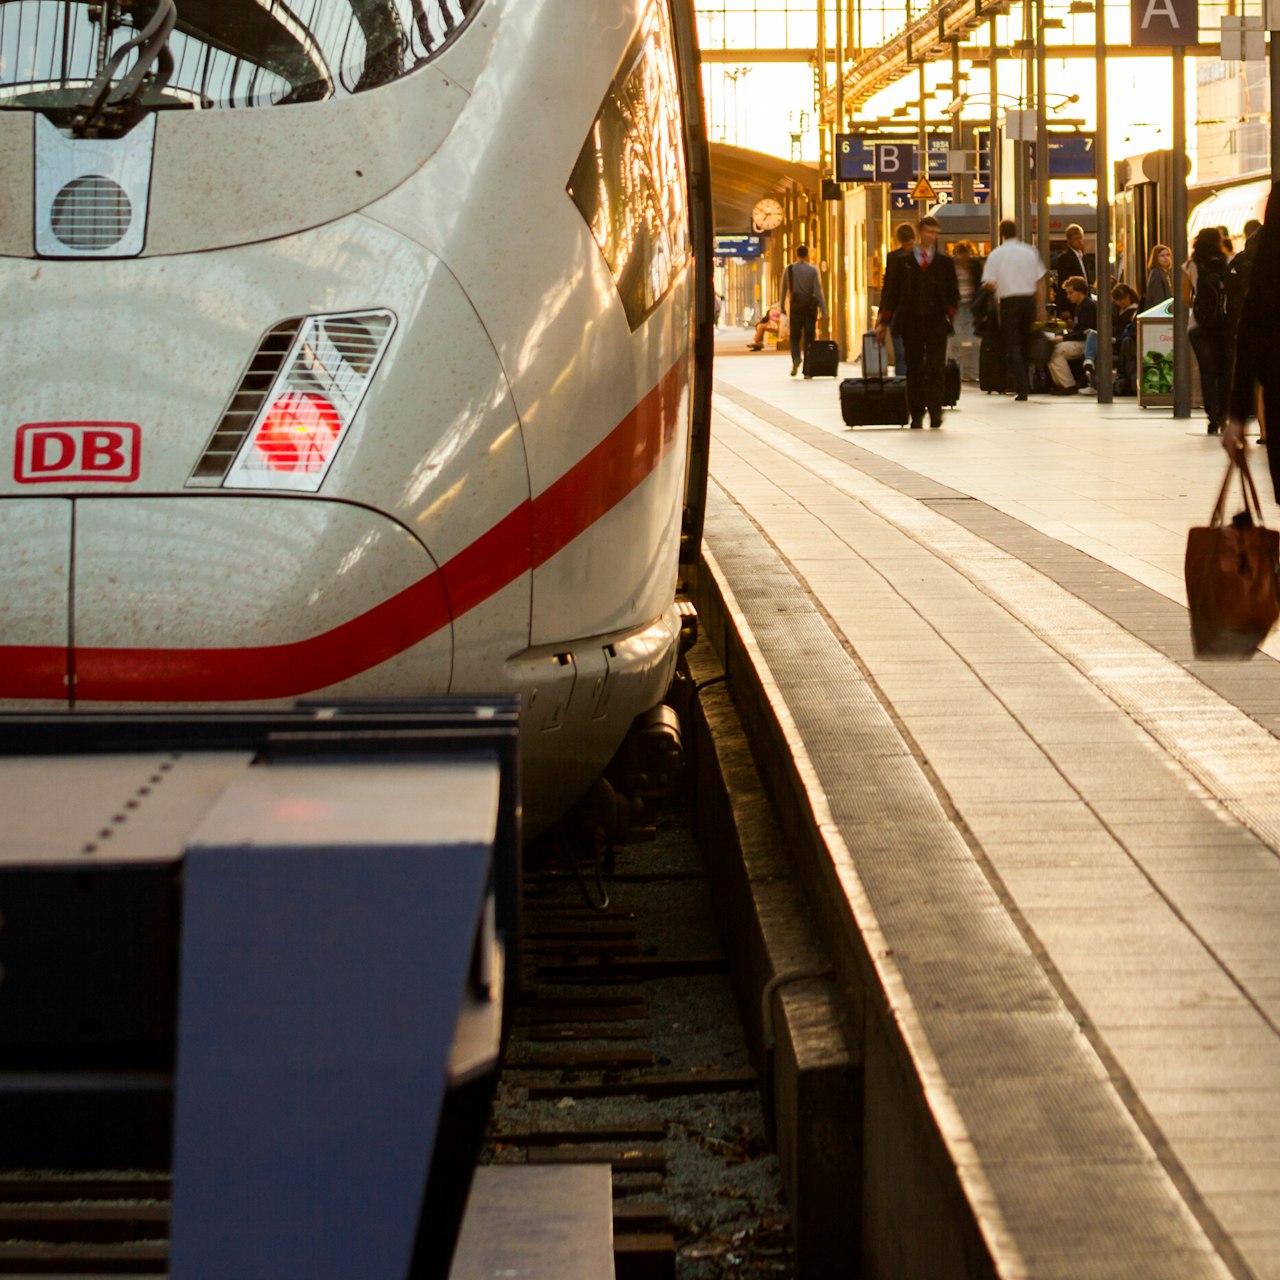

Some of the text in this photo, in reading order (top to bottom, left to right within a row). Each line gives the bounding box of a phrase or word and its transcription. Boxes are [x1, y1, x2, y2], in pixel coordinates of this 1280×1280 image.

[842, 141, 851, 154] 6
[1084, 138, 1093, 151] 7
[880, 145, 901, 173] B
[30, 430, 125, 473] DB
